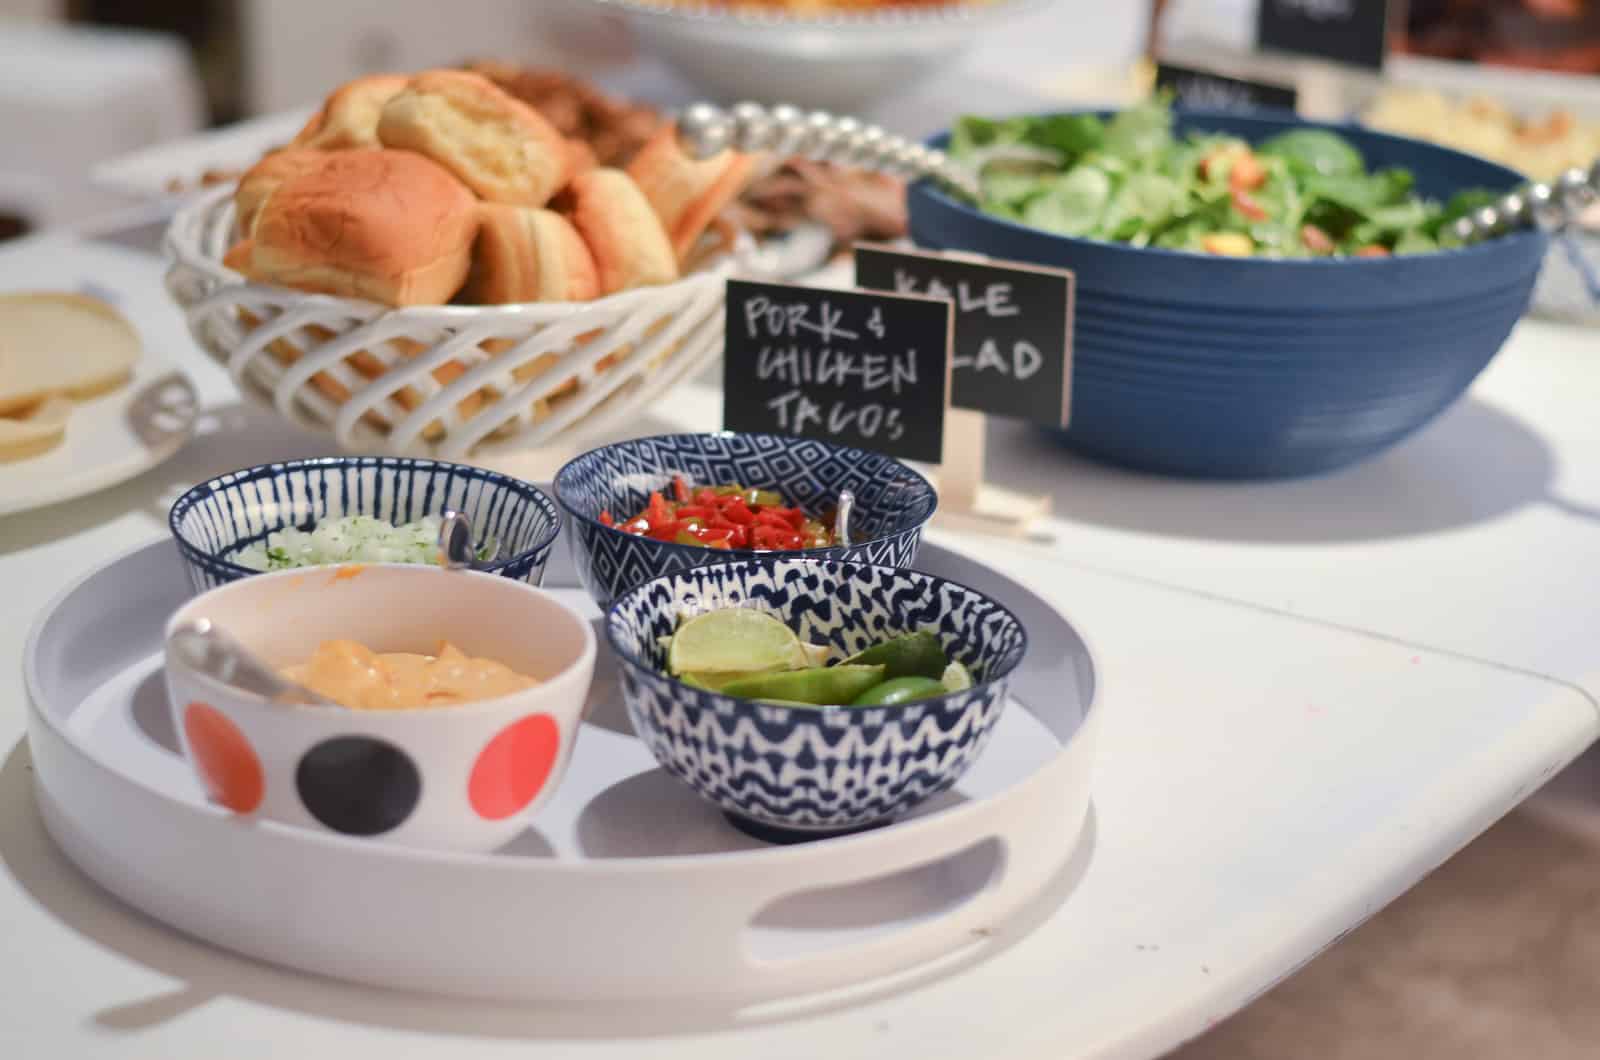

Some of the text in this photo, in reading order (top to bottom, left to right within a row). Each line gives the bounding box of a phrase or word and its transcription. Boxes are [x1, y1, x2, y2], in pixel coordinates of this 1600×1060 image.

[895, 270, 1020, 317] KALE
[744, 296, 886, 342] PORK &
[757, 346, 917, 392] CHICKEN
[768, 391, 905, 440] TACOS
